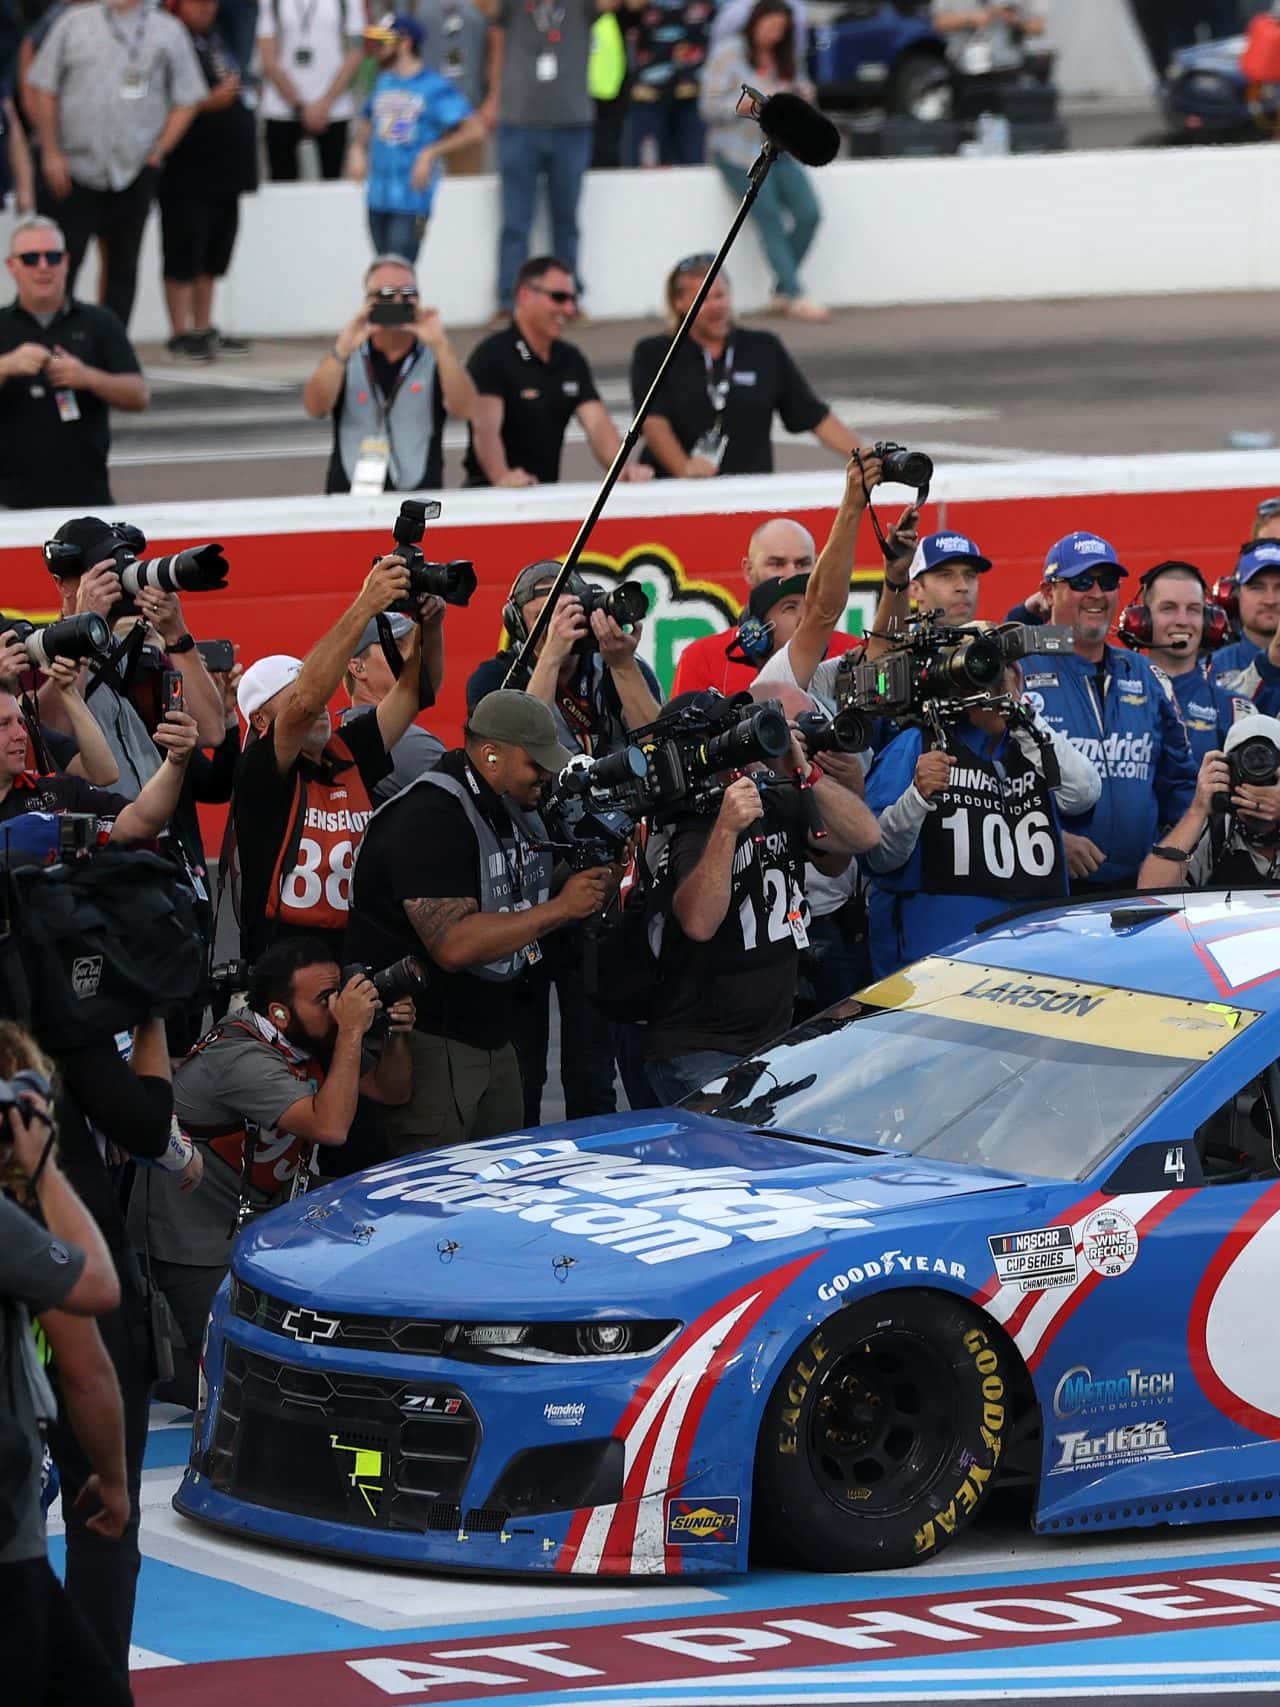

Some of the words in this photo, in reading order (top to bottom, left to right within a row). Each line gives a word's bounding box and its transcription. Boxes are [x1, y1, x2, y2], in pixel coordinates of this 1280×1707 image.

[941, 807, 1056, 879] 106
[960, 979, 1105, 1018] LARSON
[1163, 1147, 1186, 1183] 4
[1015, 1231, 1060, 1251] NASCAR
[1095, 1233, 1128, 1246] WINS
[1088, 1243, 1135, 1260] RECORD
[1006, 1256, 1027, 1273] CUP
[1027, 1251, 1064, 1270] SERIES
[1106, 1264, 1121, 1275] 269
[816, 1251, 967, 1301] GOODYEAR
[1022, 1273, 1076, 1291] CHAMPIONSHIP
[403, 1395, 463, 1414] ZL1
[544, 1402, 586, 1418] Hendrick
[1080, 1395, 1175, 1416] AUTOMOTIVE
[1055, 1425, 1168, 1468] Tarlton
[672, 1516, 733, 1529] SUNOCO
[344, 1641, 606, 1695] AT
